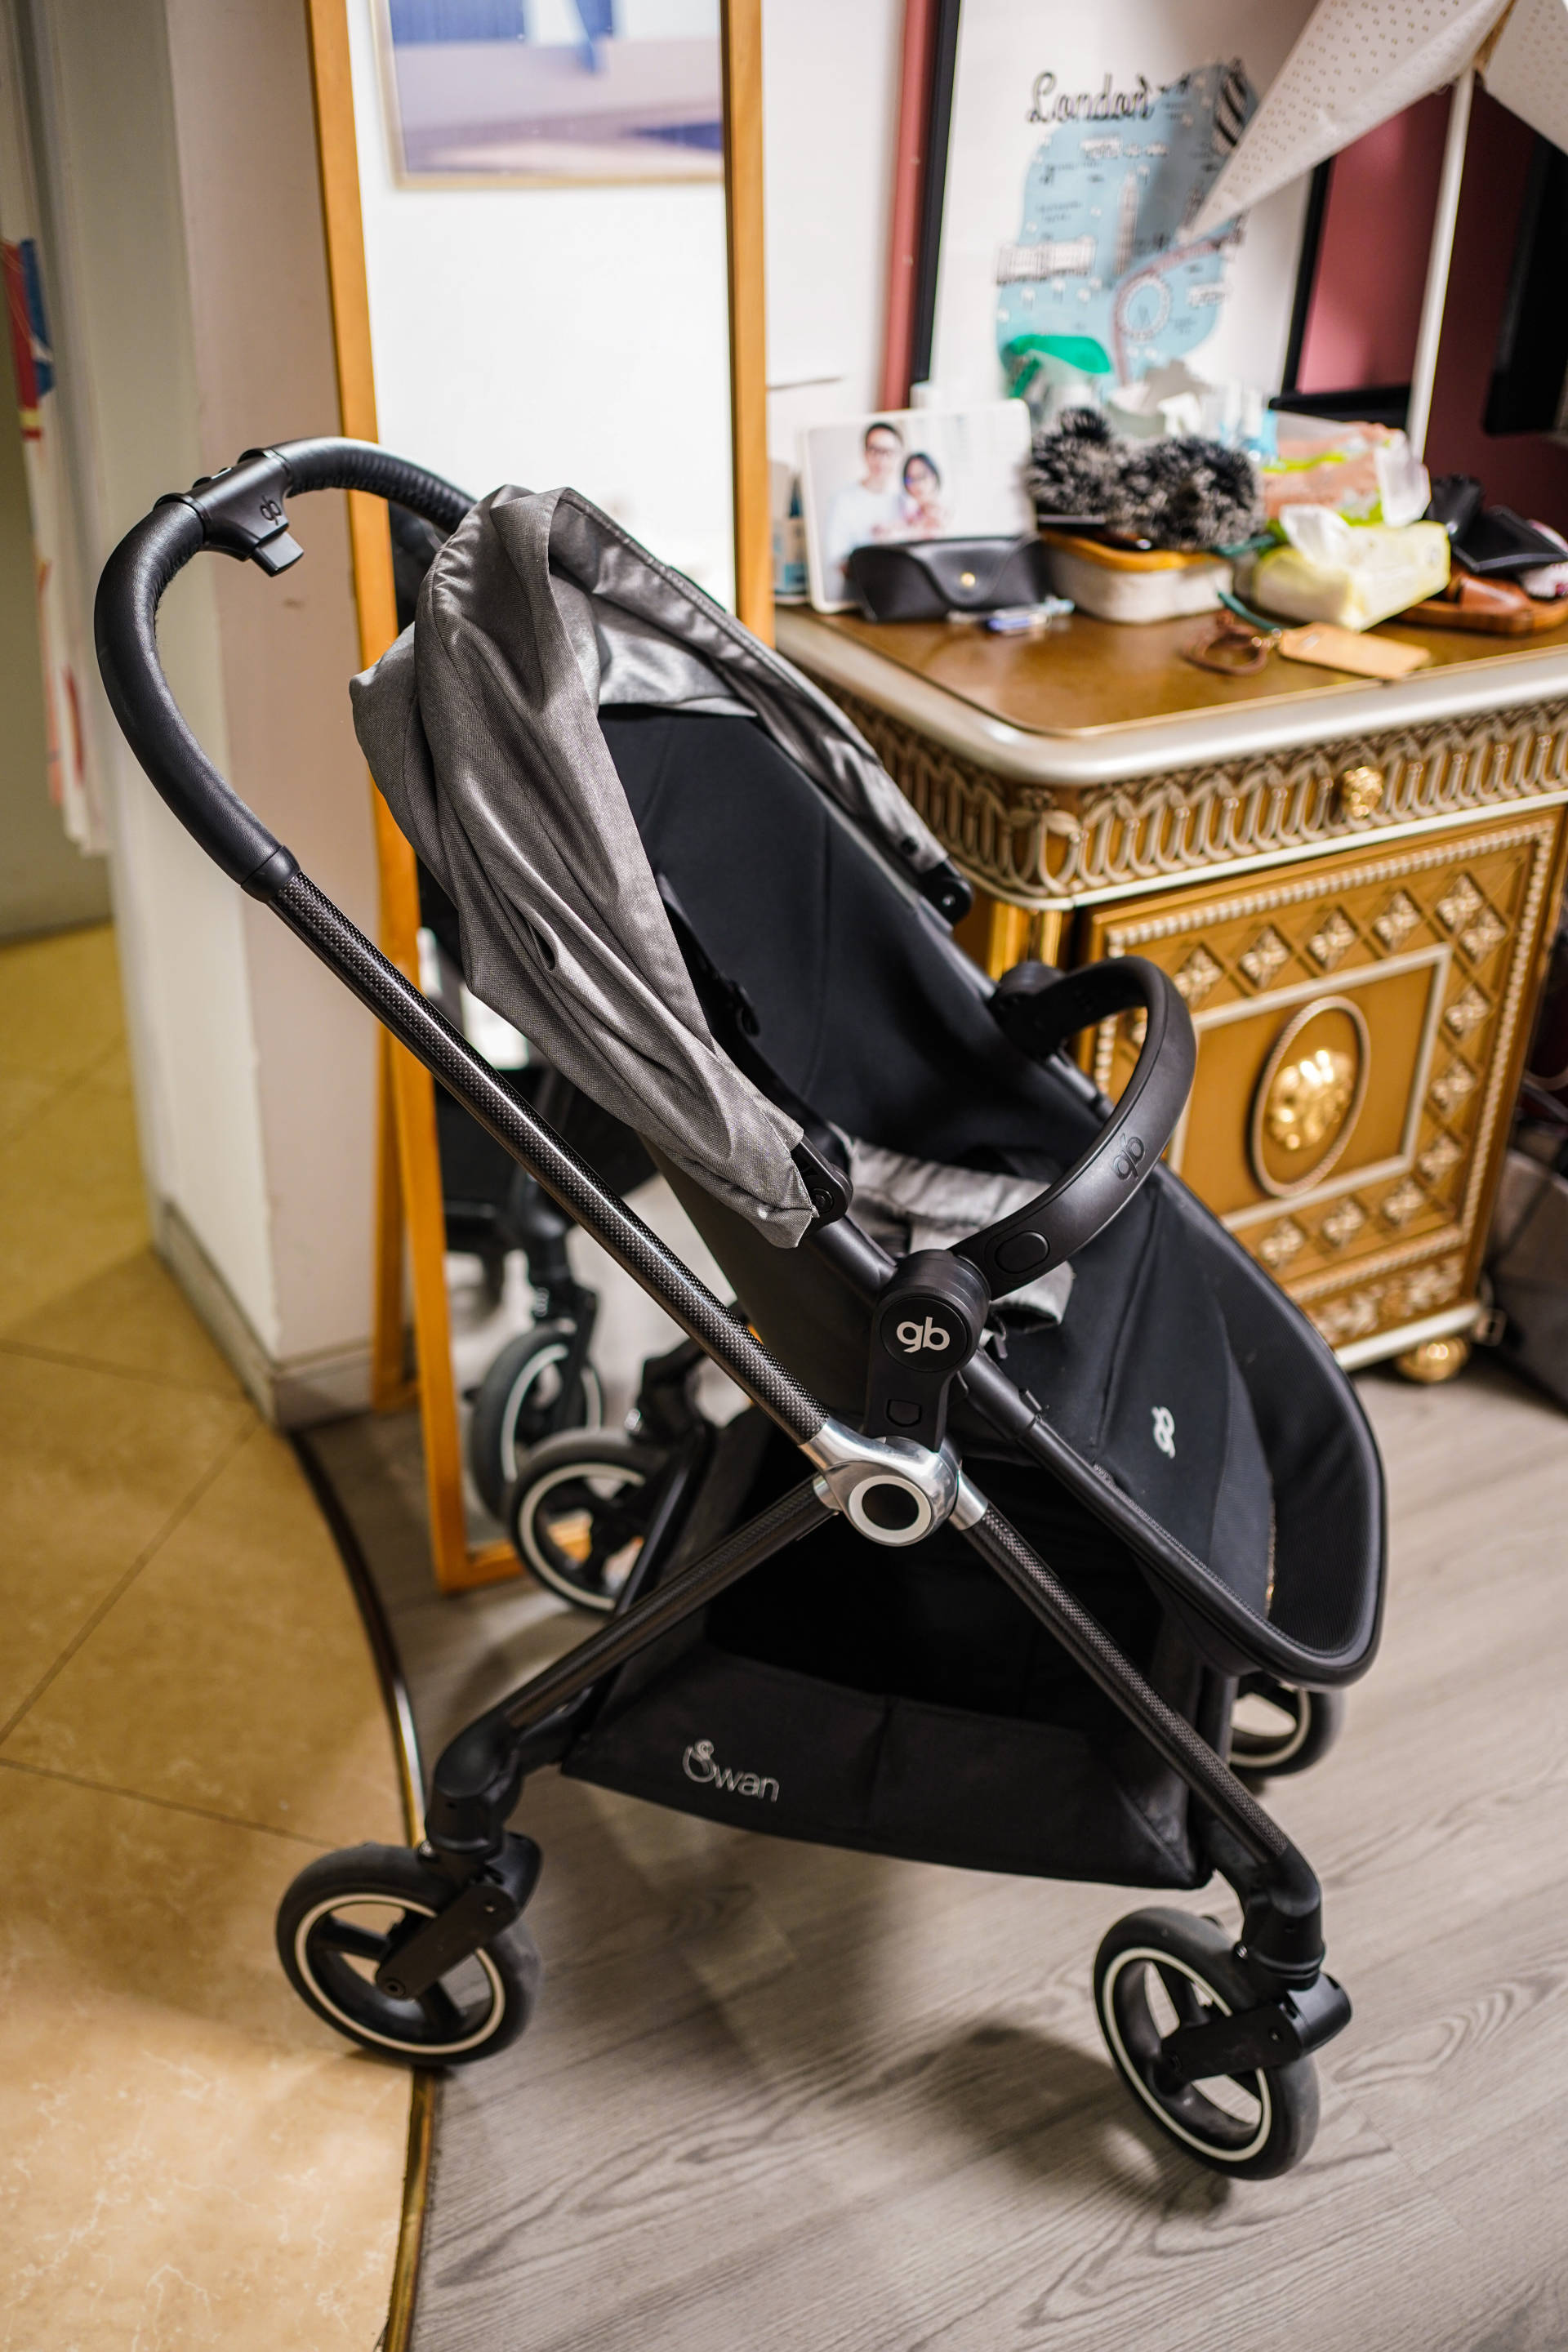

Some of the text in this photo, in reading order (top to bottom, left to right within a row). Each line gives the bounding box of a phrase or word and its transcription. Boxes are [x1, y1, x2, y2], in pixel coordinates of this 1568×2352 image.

[1027, 71, 1153, 122] London
[897, 1316, 950, 1352] gb
[682, 1738, 781, 1802] Swan
